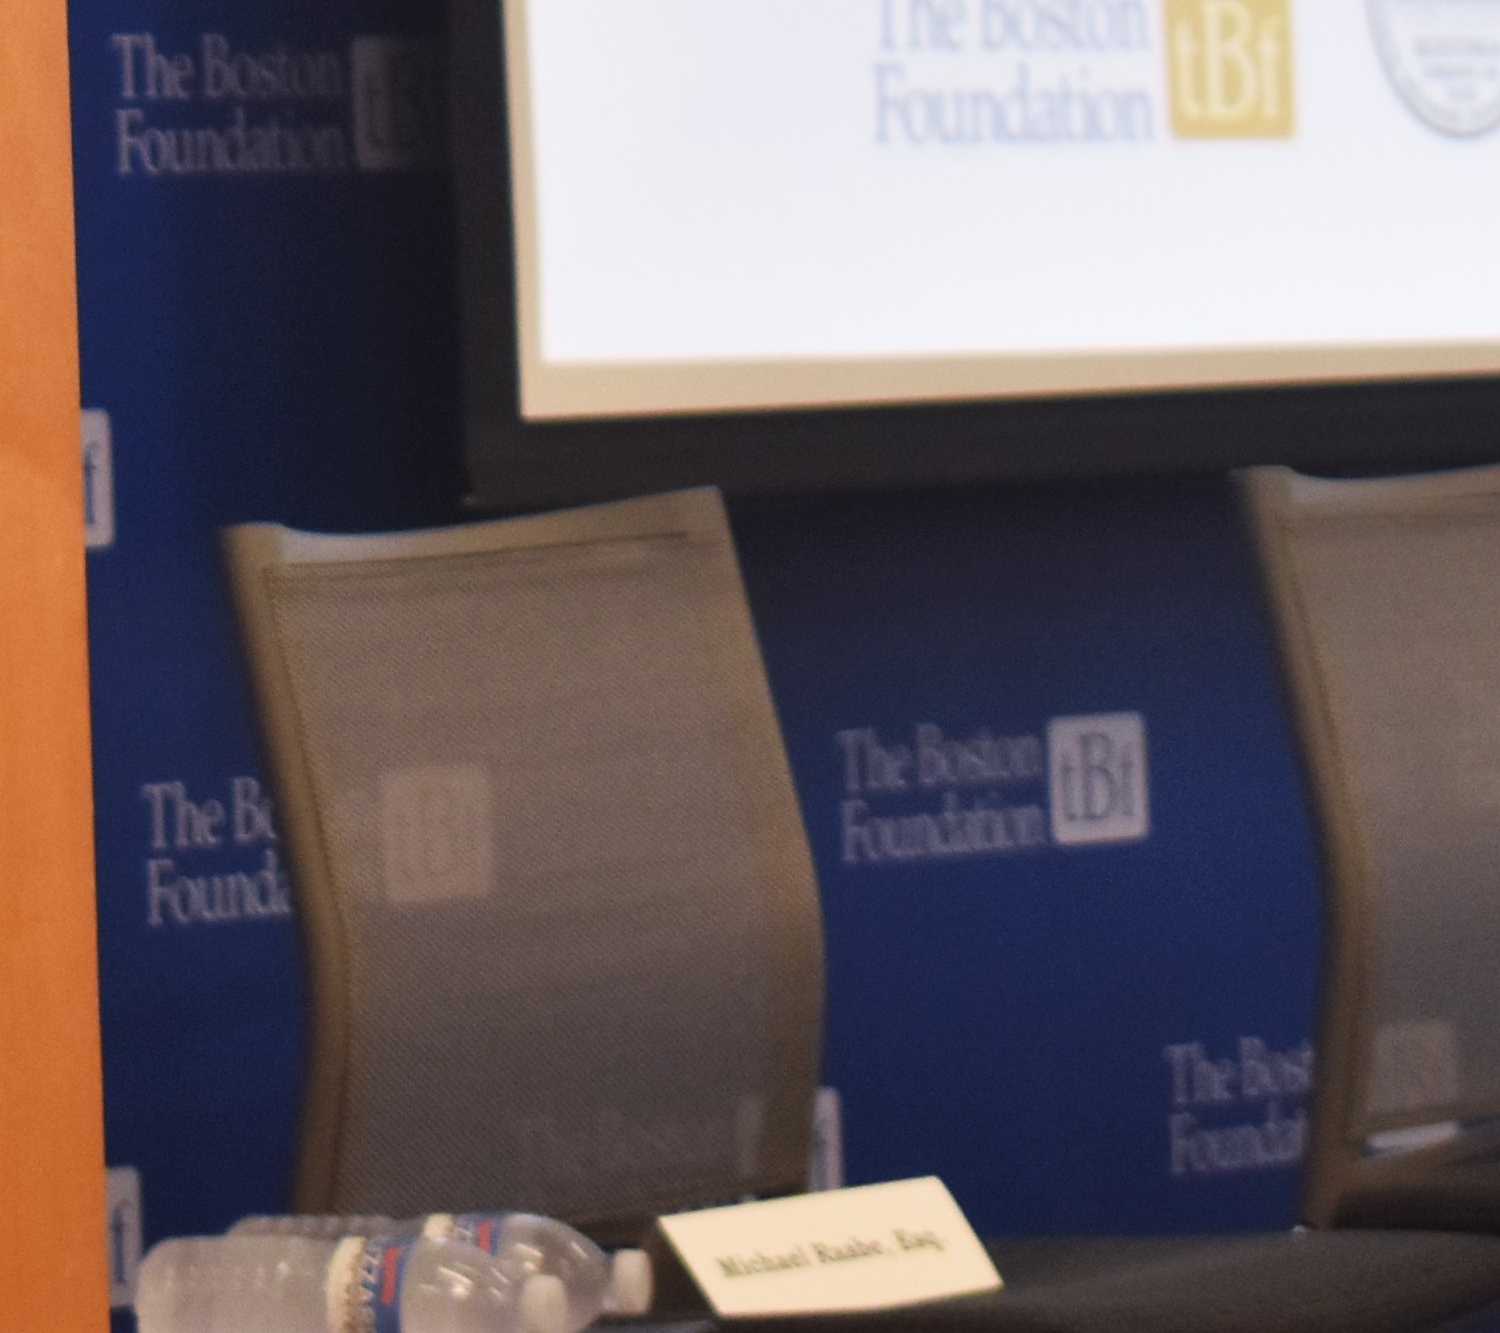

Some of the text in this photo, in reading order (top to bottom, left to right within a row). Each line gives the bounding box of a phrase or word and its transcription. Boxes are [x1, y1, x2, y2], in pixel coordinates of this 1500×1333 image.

[110, 32, 195, 100] The
[873, 62, 1156, 146] Foundation
[141, 780, 226, 850] The
